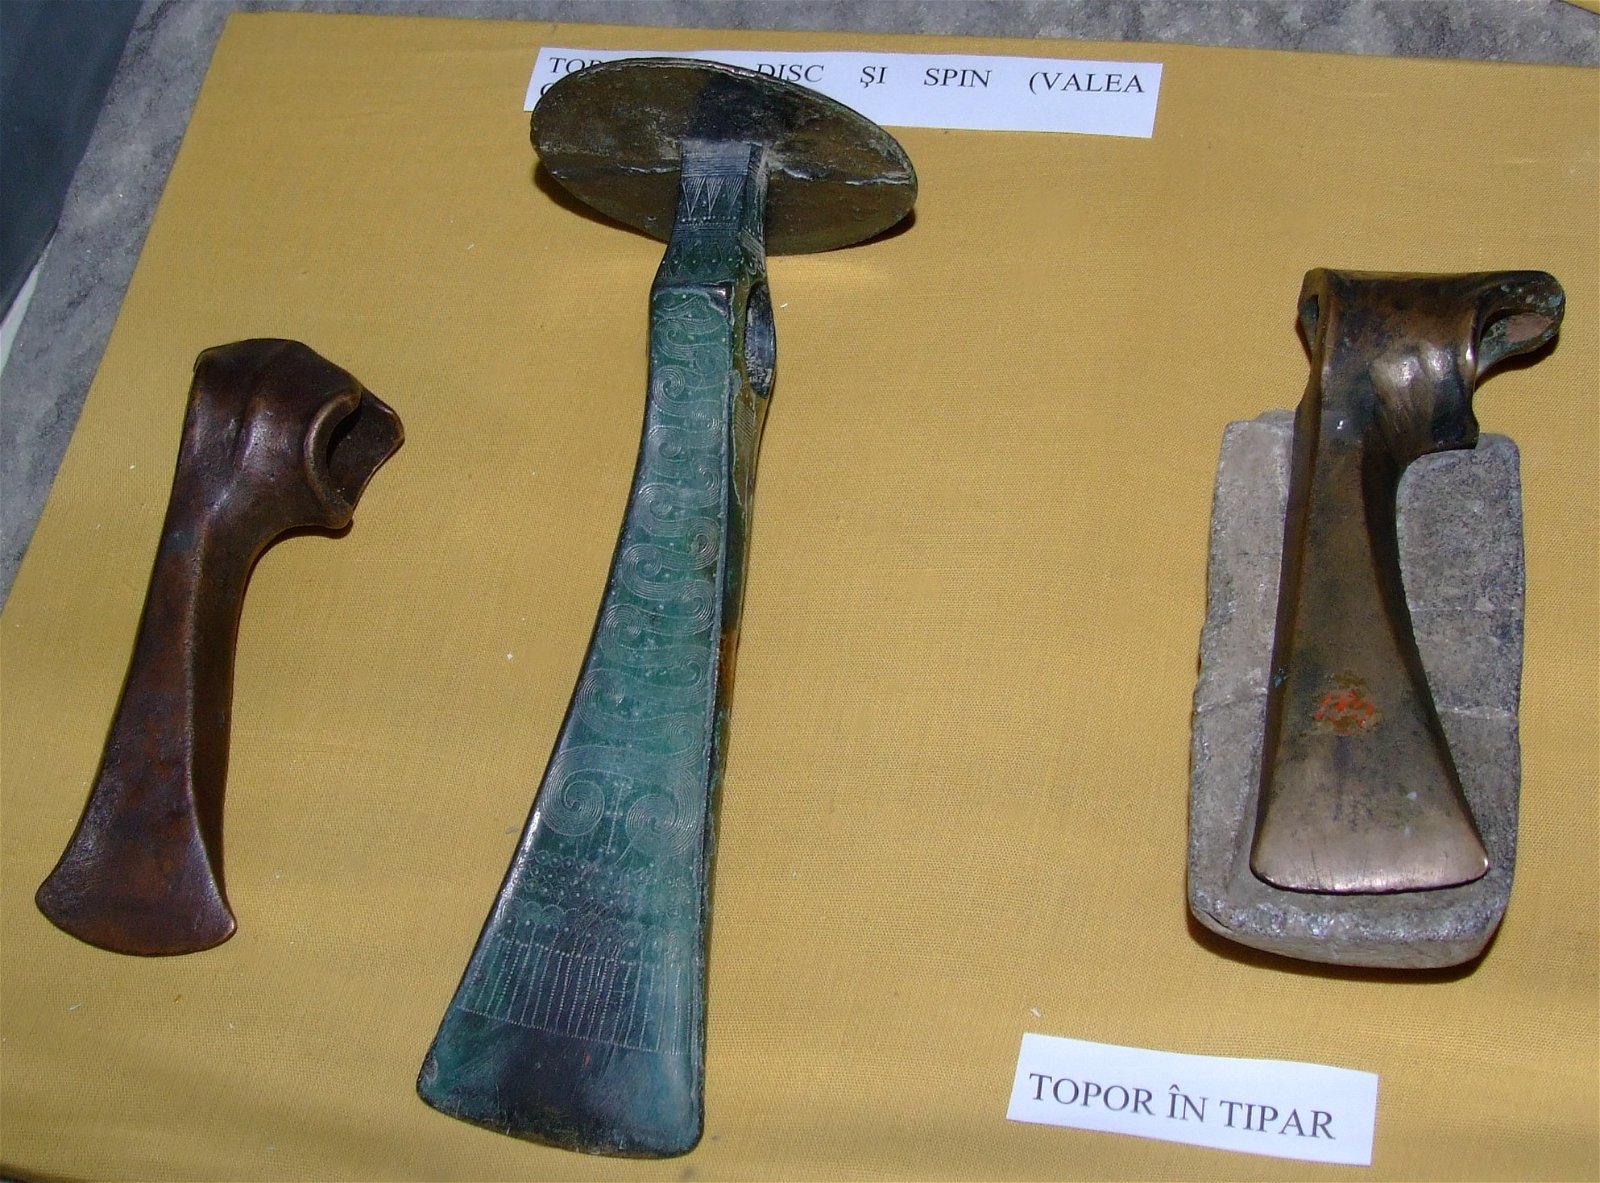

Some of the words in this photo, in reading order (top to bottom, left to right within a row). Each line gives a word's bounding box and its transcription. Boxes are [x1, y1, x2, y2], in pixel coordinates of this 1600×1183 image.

[757, 63, 824, 82] DISC
[924, 68, 992, 88] SPIN
[1029, 71, 1145, 95] (VALEA
[1029, 1073, 1156, 1116] TOPOR
[1166, 1084, 1208, 1123] ÎN
[1219, 1100, 1336, 1140] TIPAR
